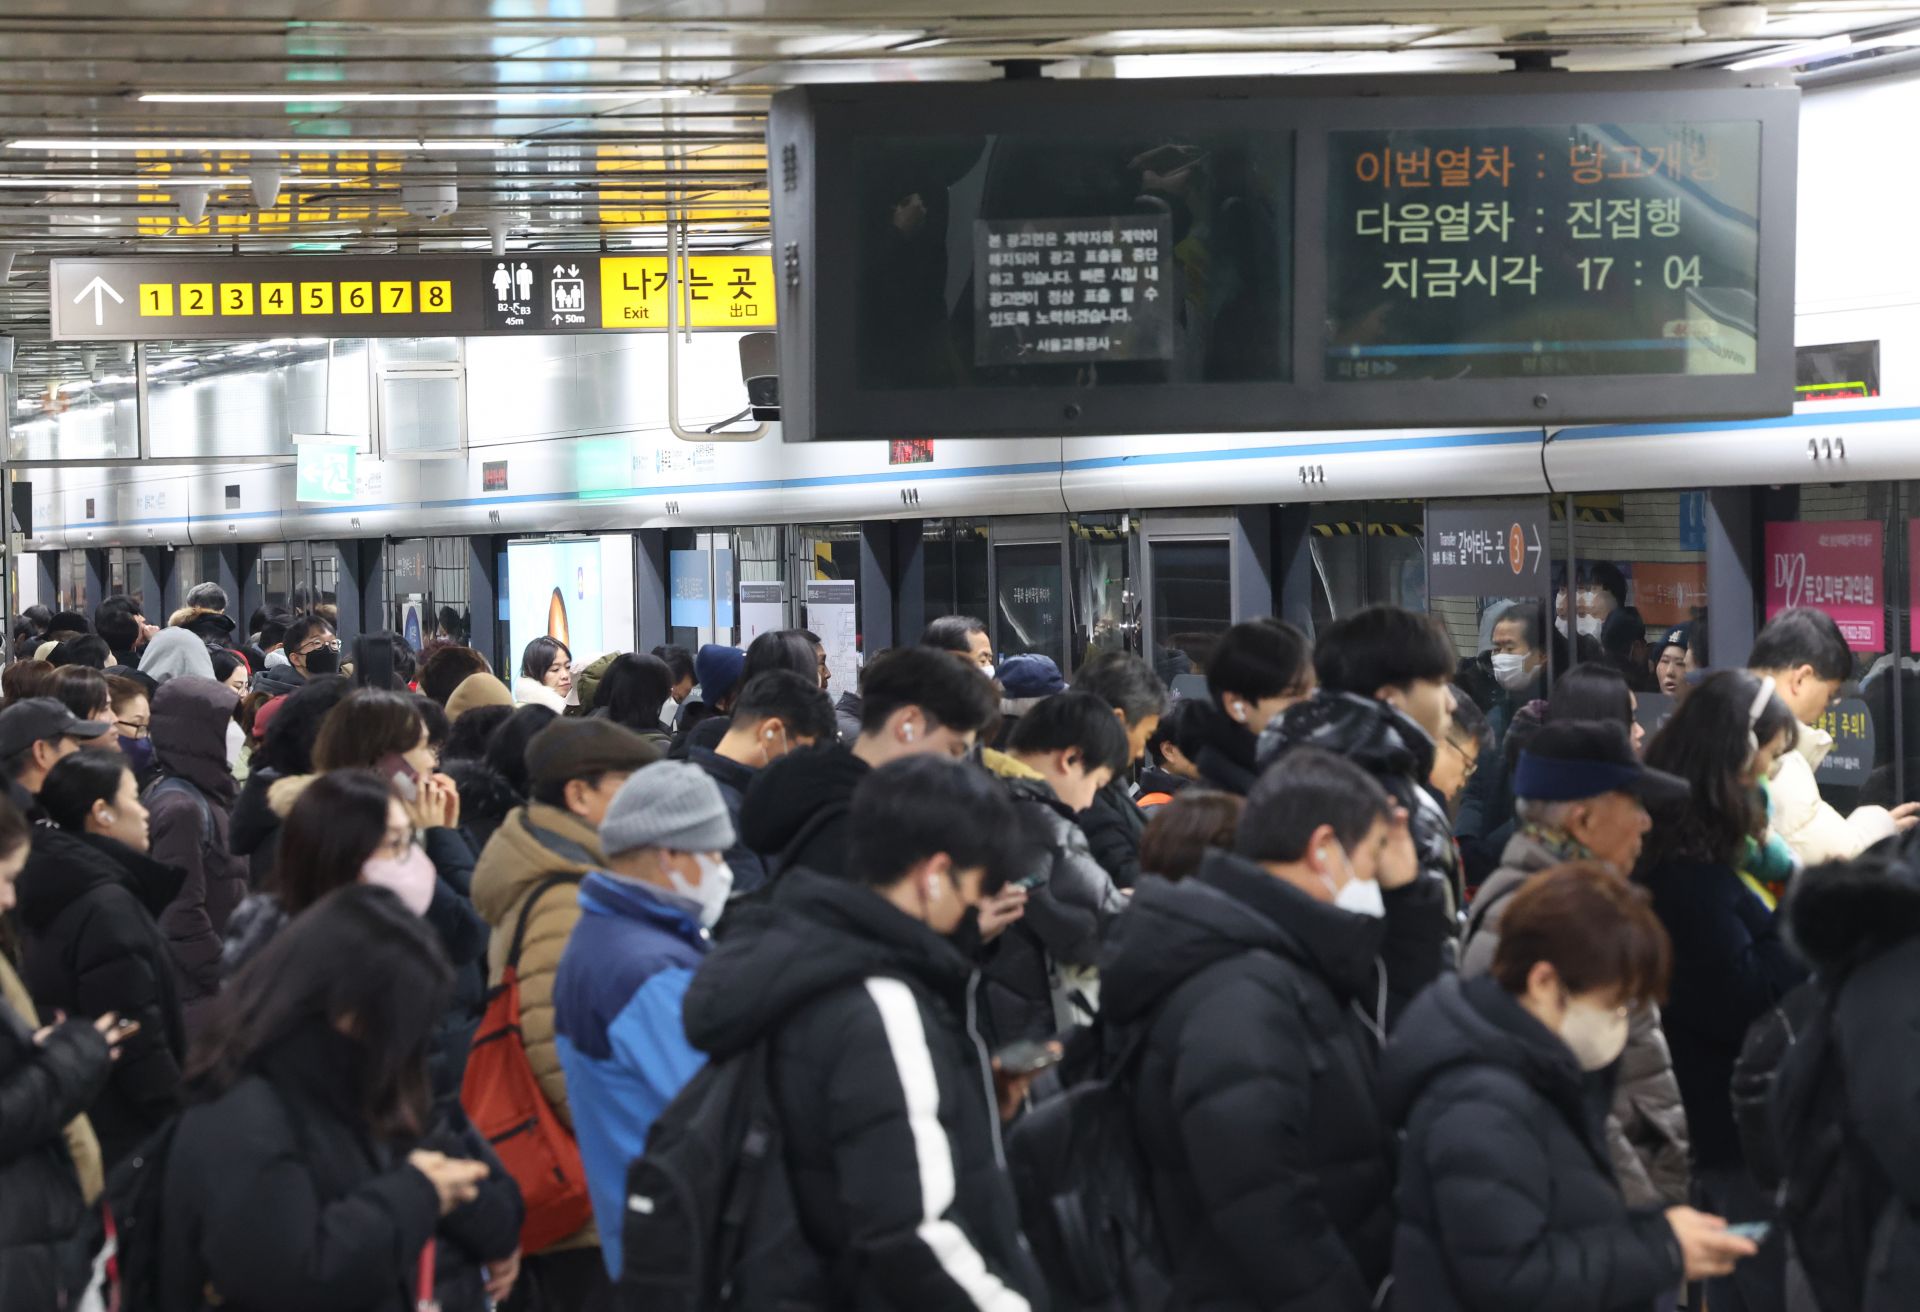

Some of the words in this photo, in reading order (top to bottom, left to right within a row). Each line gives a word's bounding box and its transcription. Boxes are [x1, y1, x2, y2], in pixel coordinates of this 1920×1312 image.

[1356, 144, 1515, 189] 이번열차
[1355, 200, 1515, 244] 다음열차
[1565, 196, 1682, 240] 진접행
[1050, 250, 1075, 265] 광고
[1132, 247, 1158, 262] 중단
[1144, 265, 1159, 281] 내
[1382, 254, 1543, 299] 지금시각
[1576, 256, 1614, 291] 17
[1663, 254, 1703, 290] 04
[622, 268, 714, 300] 나가는
[727, 267, 757, 300] 곳
[150, 290, 160, 310] 1
[190, 289, 204, 310] 2
[230, 289, 244, 310] 3
[268, 288, 283, 308] 4
[310, 288, 324, 308] 5
[350, 287, 365, 308] 6
[390, 287, 404, 307] 7
[429, 286, 444, 307] 8
[1144, 286, 1159, 301] 수
[497, 303, 509, 312] B2
[520, 306, 531, 315] B3
[624, 307, 650, 320] Exit
[730, 303, 758, 318] 出口
[505, 316, 524, 326] 45m
[565, 314, 586, 324] 50m
[1458, 530, 1494, 566] 갈아타는
[1495, 530, 1505, 565] 곳
[1841, 712, 1866, 739] 주의!
